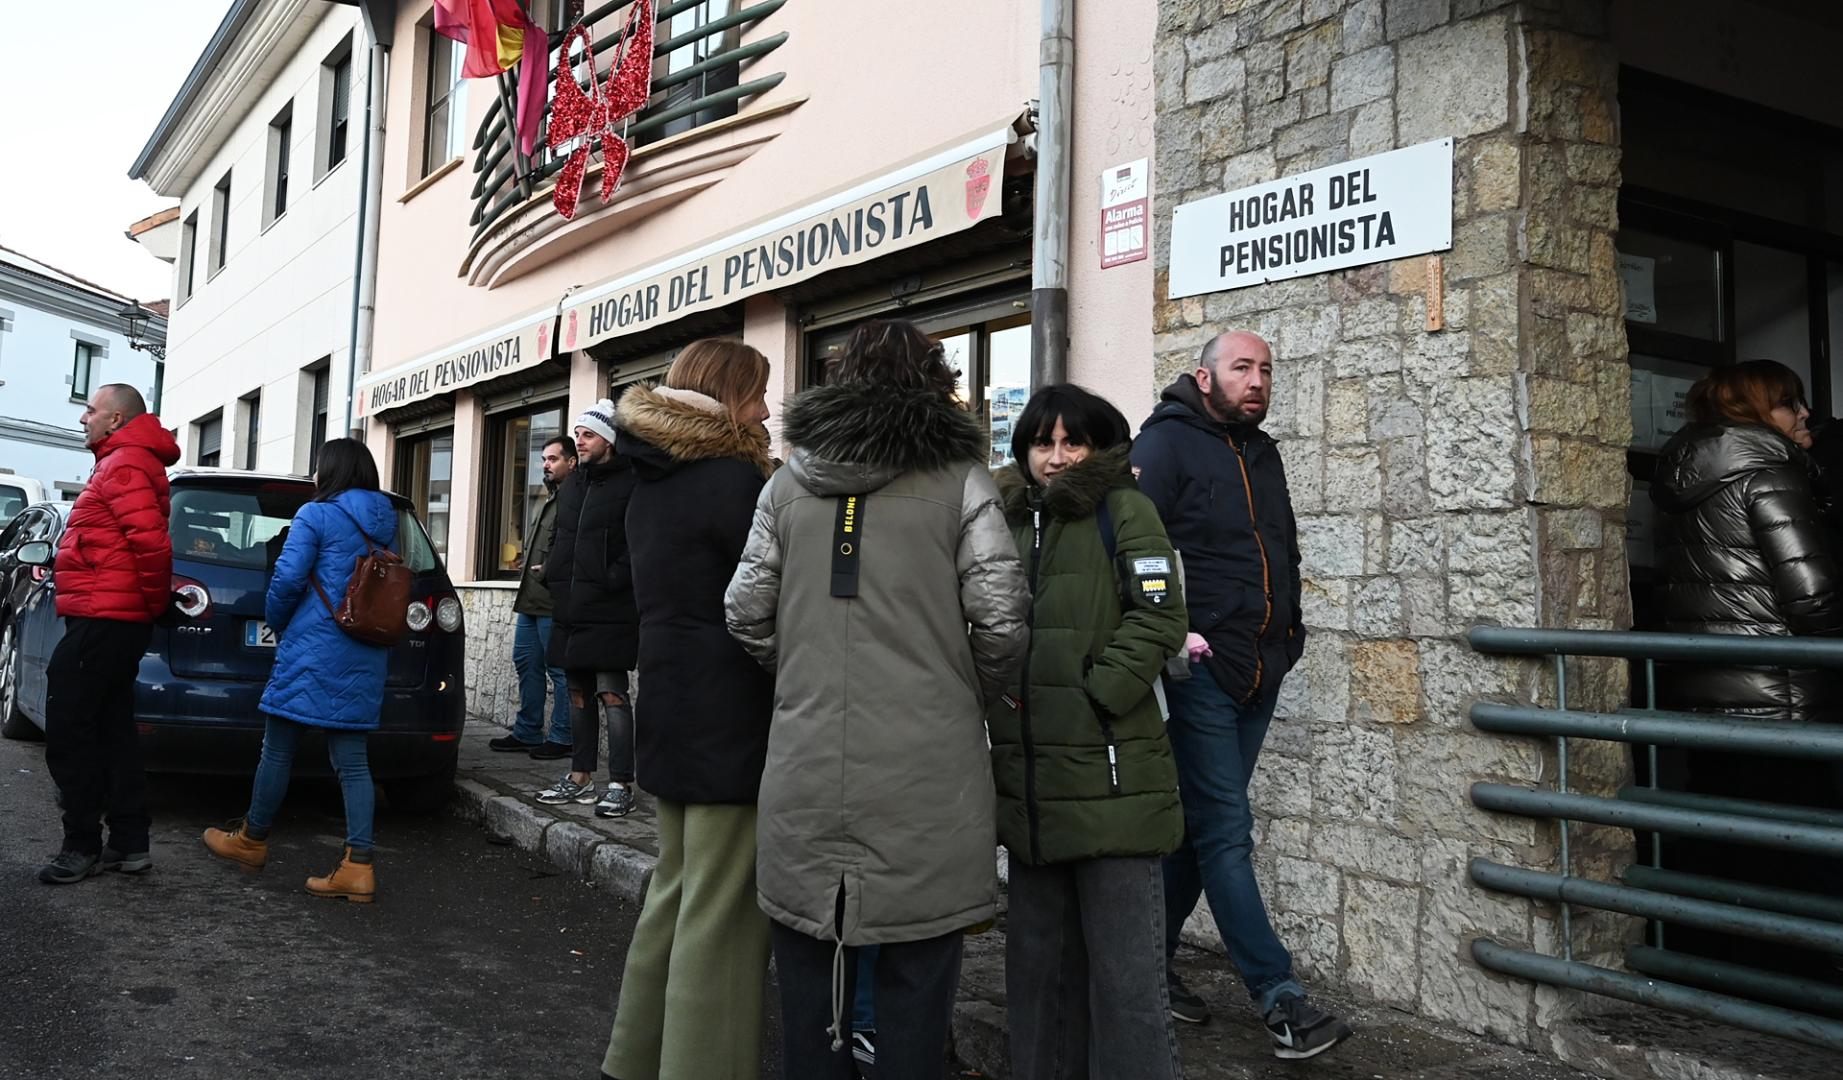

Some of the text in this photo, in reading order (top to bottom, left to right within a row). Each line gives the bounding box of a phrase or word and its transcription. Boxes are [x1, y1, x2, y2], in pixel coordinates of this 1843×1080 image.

[1105, 204, 1144, 225] Alarma
[1229, 168, 1377, 233] HOGAR DEL
[588, 185, 933, 337] HOGAR DEL PENSIONISTA
[1220, 211, 1396, 277] PENSIONISTA
[371, 336, 520, 409] HOGAR DEL PENSIONISTA
[176, 626, 212, 636] GOLF
[408, 639, 425, 649] TDI
